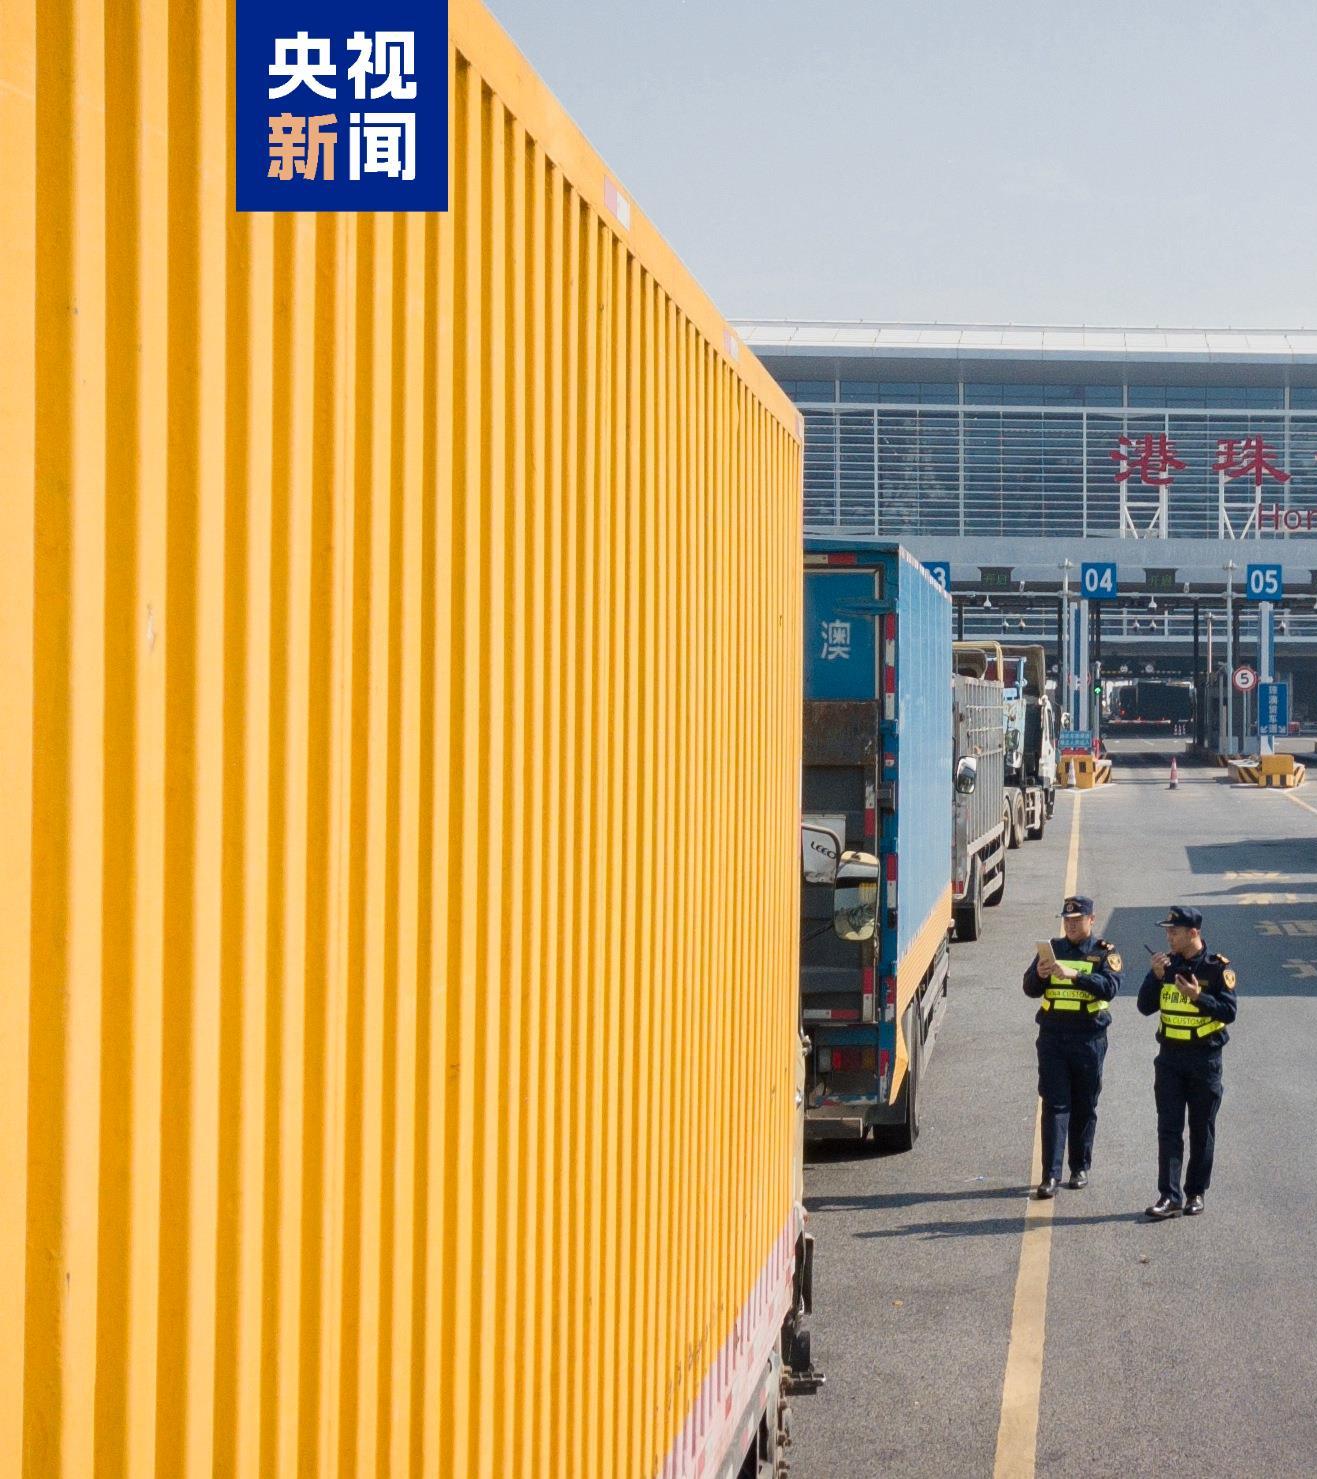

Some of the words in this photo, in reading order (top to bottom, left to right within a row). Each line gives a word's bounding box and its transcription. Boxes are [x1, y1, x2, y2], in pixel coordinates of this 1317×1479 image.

[1085, 568, 1113, 592] 04
[1250, 570, 1279, 594] 05
[820, 619, 851, 661] 澳
[1239, 672, 1250, 685] 5
